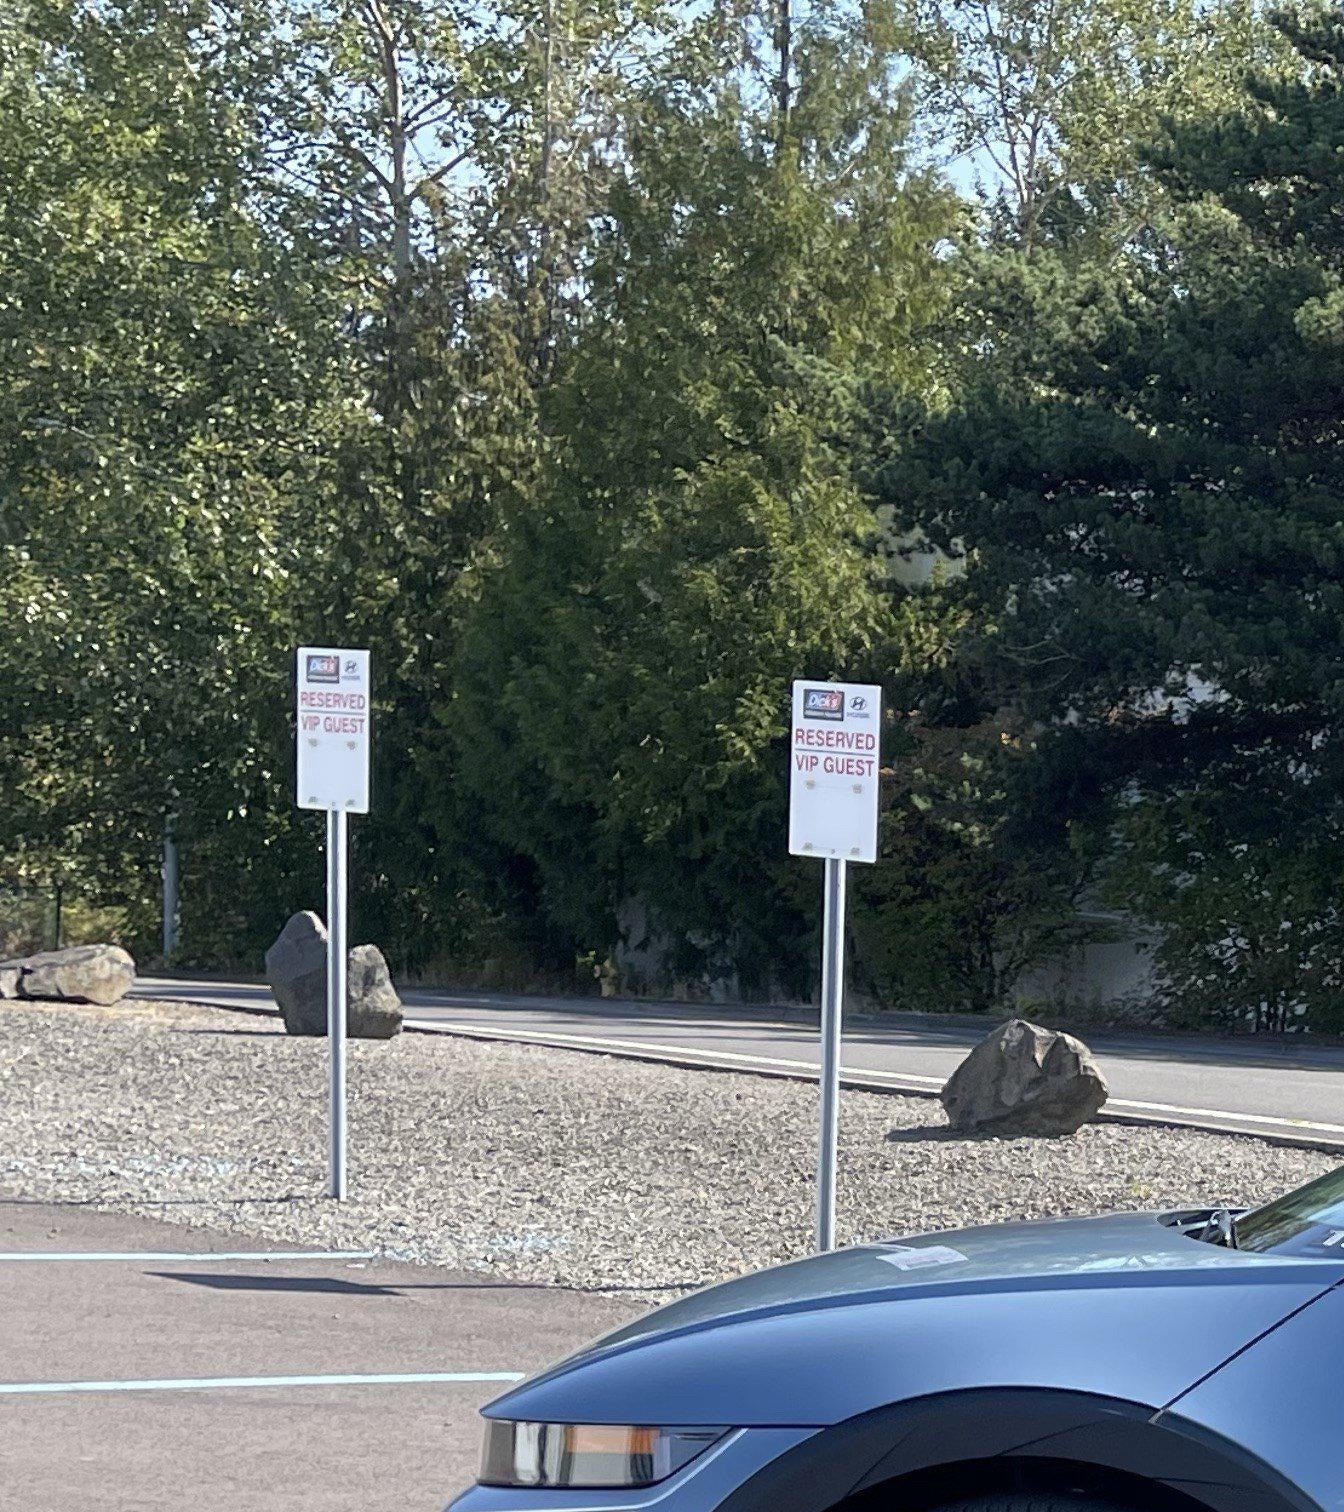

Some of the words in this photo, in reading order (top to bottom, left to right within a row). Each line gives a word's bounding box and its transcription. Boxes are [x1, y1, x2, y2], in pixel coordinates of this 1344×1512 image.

[300, 691, 366, 710] RESERVED
[301, 716, 320, 732] VIP
[324, 717, 365, 734] GUEST
[795, 728, 875, 750] RESERVED
[796, 754, 819, 772] VIP
[823, 756, 875, 778] GUEST
